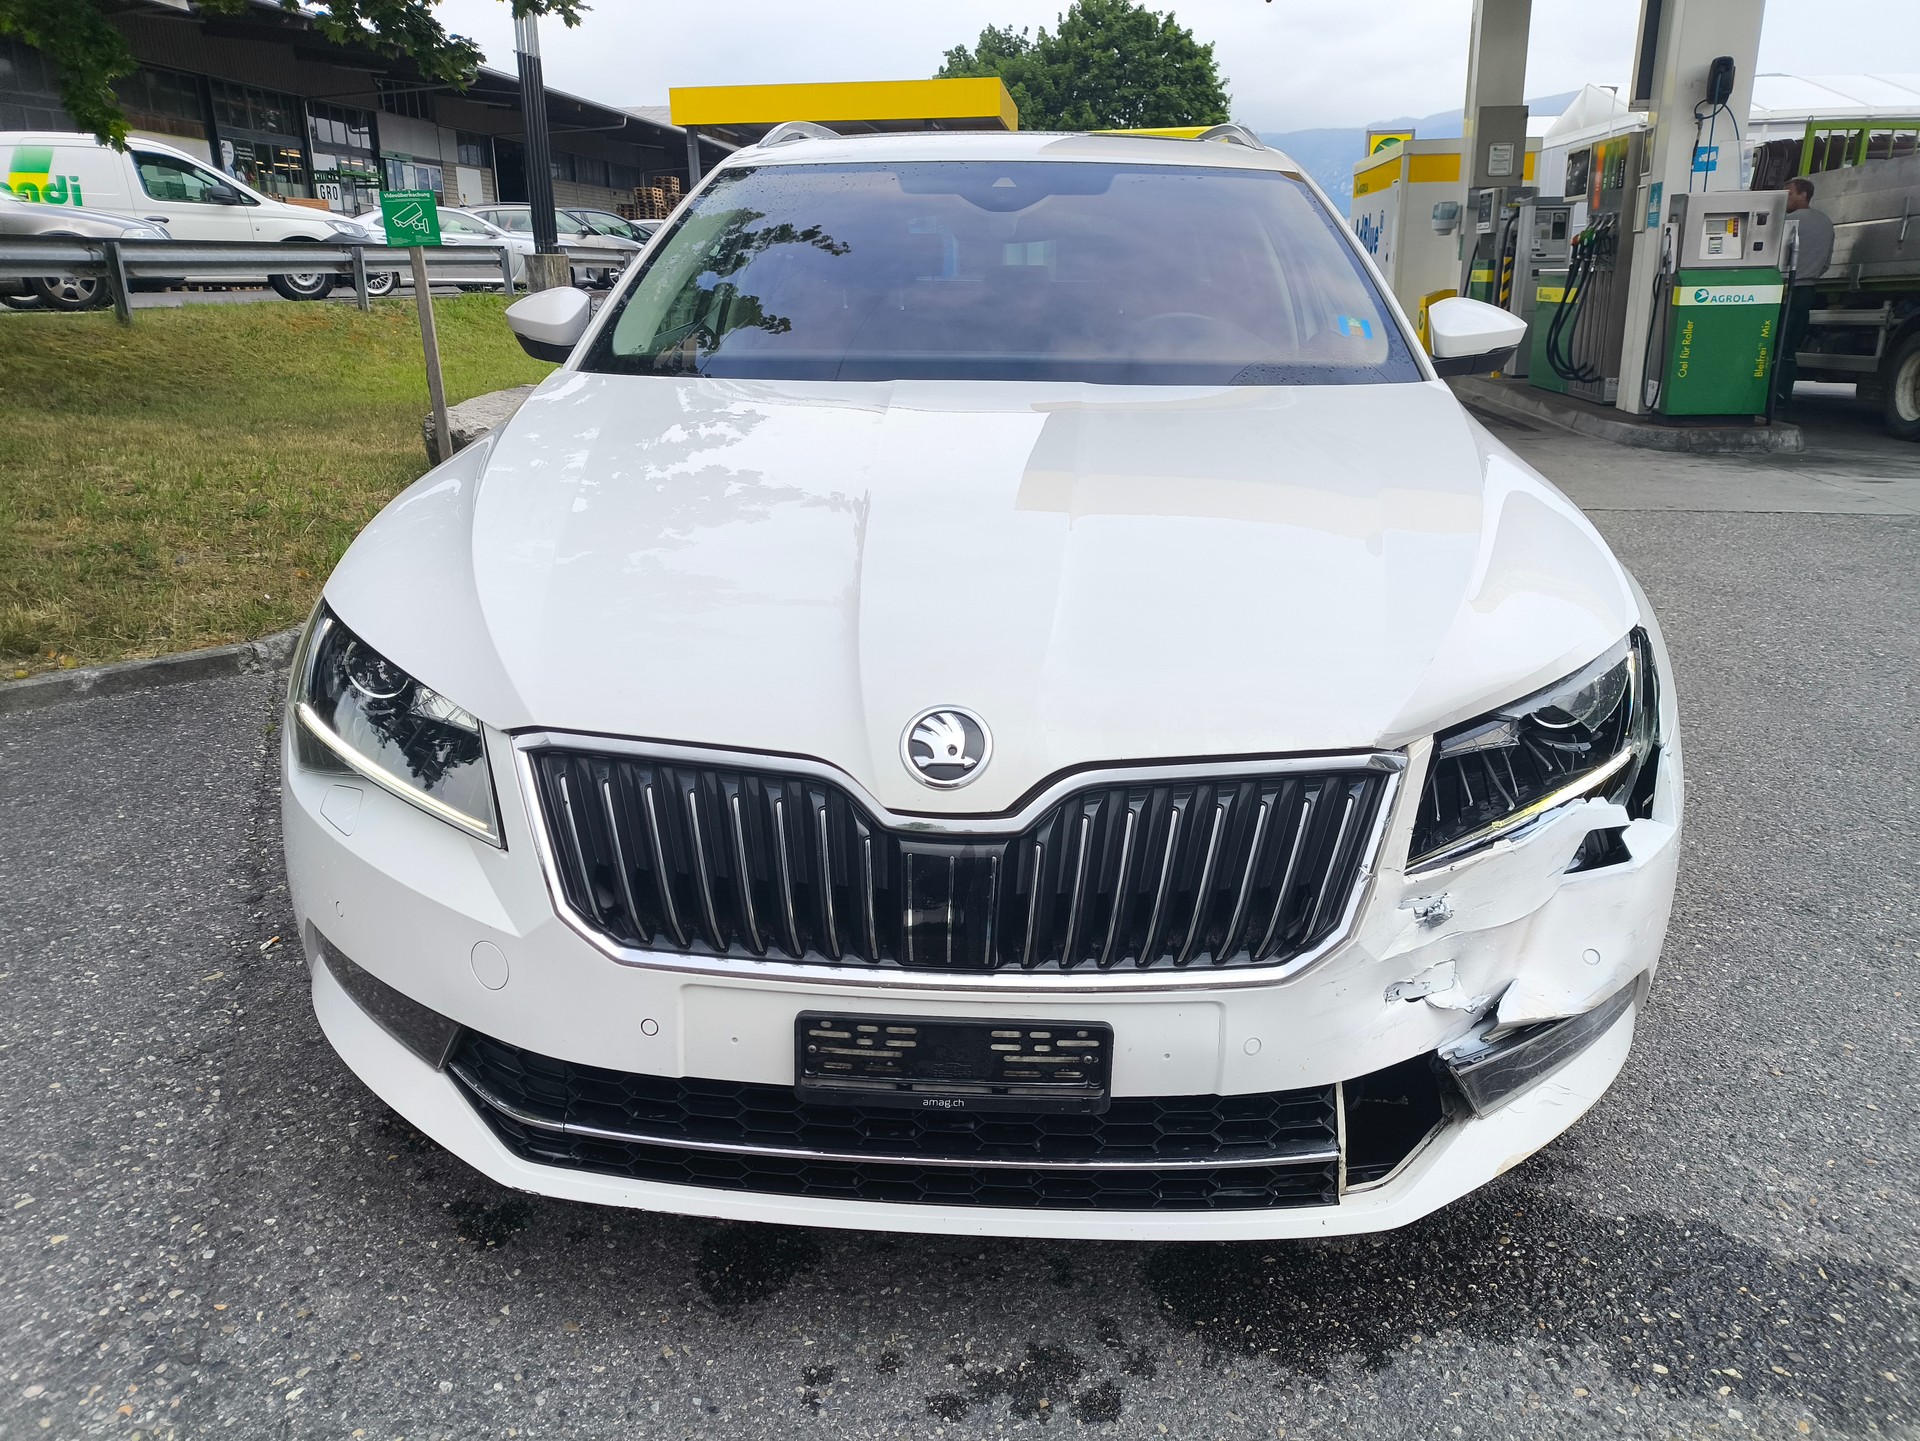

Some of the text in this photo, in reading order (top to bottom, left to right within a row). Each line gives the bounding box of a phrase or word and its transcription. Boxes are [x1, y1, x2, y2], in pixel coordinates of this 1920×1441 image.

[0, 175, 83, 206] ndi
[320, 184, 339, 200] GRO
[1710, 294, 1755, 303] AGROLA
[1760, 319, 1771, 338] Mix
[1677, 320, 1694, 378] Oel für Roller
[1754, 347, 1767, 378] Bleifrei
[922, 1098, 965, 1109] amag.ch
